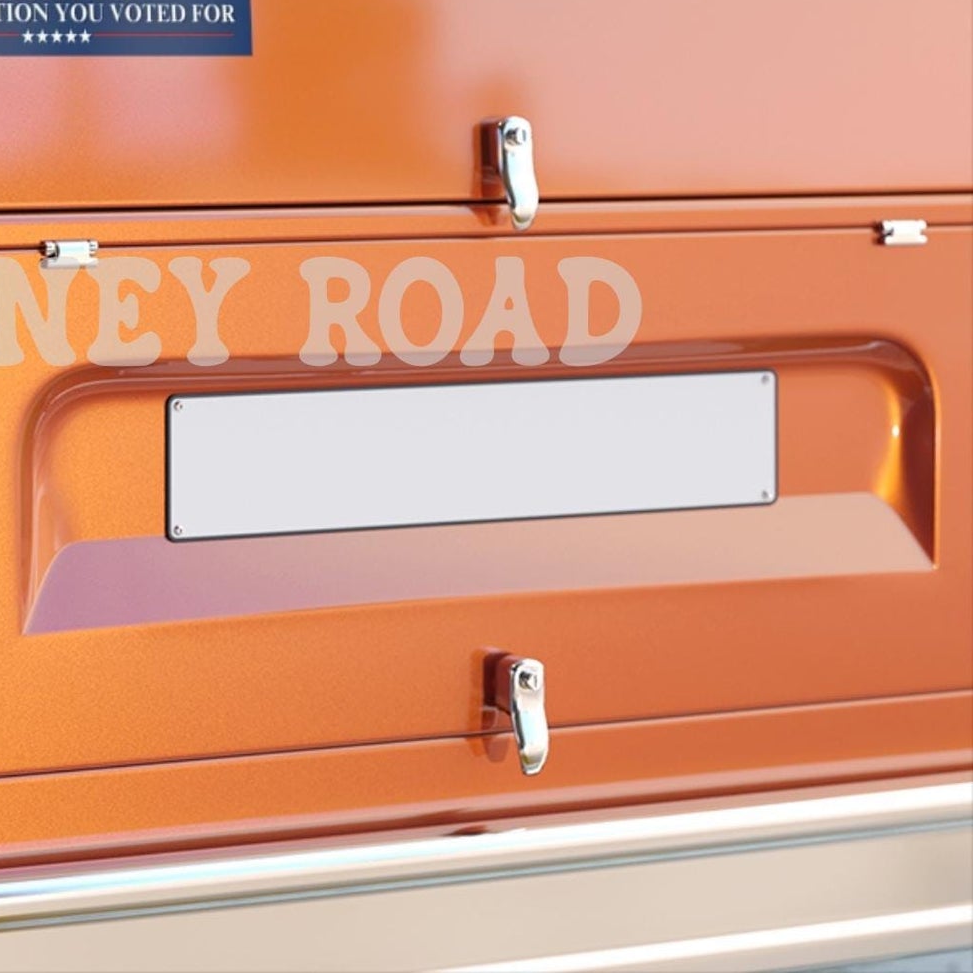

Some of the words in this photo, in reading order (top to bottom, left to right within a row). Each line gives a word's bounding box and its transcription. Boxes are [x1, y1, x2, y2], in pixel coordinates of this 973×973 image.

[56, 3, 103, 23] YOU
[110, 3, 186, 23] VOTED
[192, 4, 236, 24] FOR
